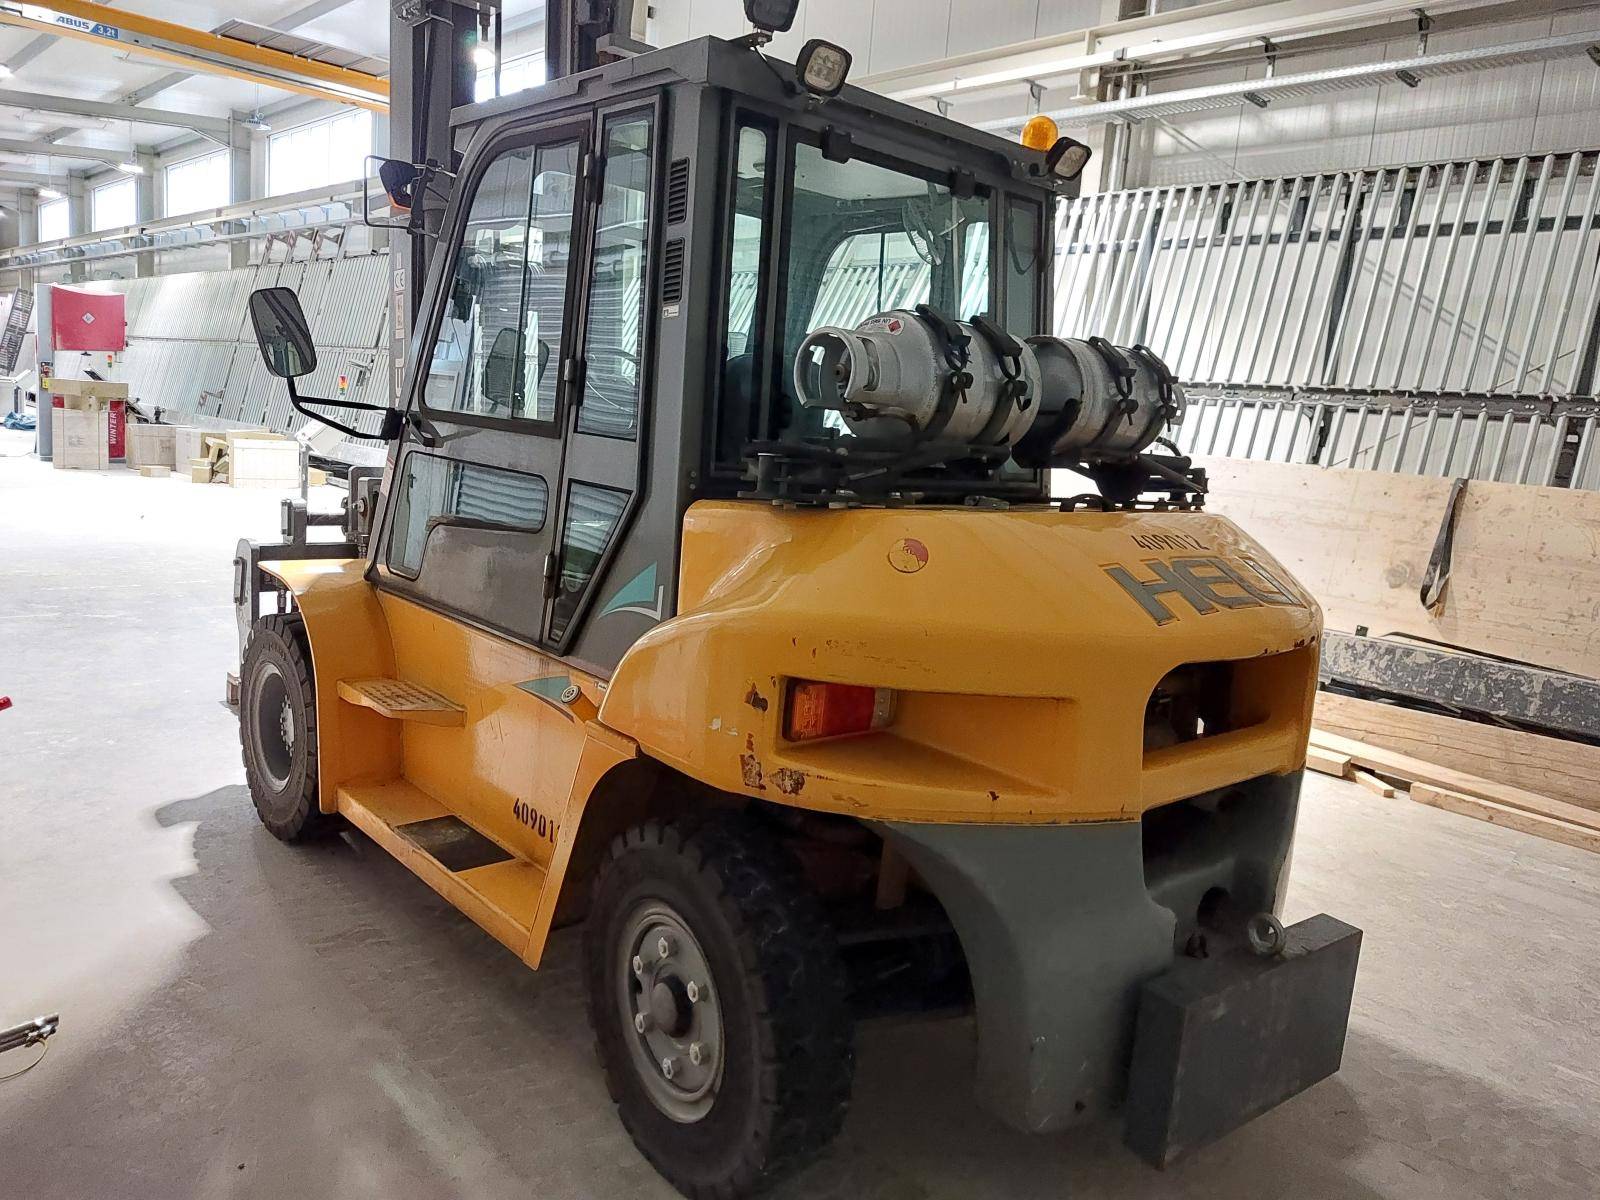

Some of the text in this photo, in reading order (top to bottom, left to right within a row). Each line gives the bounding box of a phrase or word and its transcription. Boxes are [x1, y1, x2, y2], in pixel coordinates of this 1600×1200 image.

[56, 16, 117, 38] ABUS 3,2t
[1131, 533, 1210, 551] 409012
[513, 797, 560, 844] 40901
